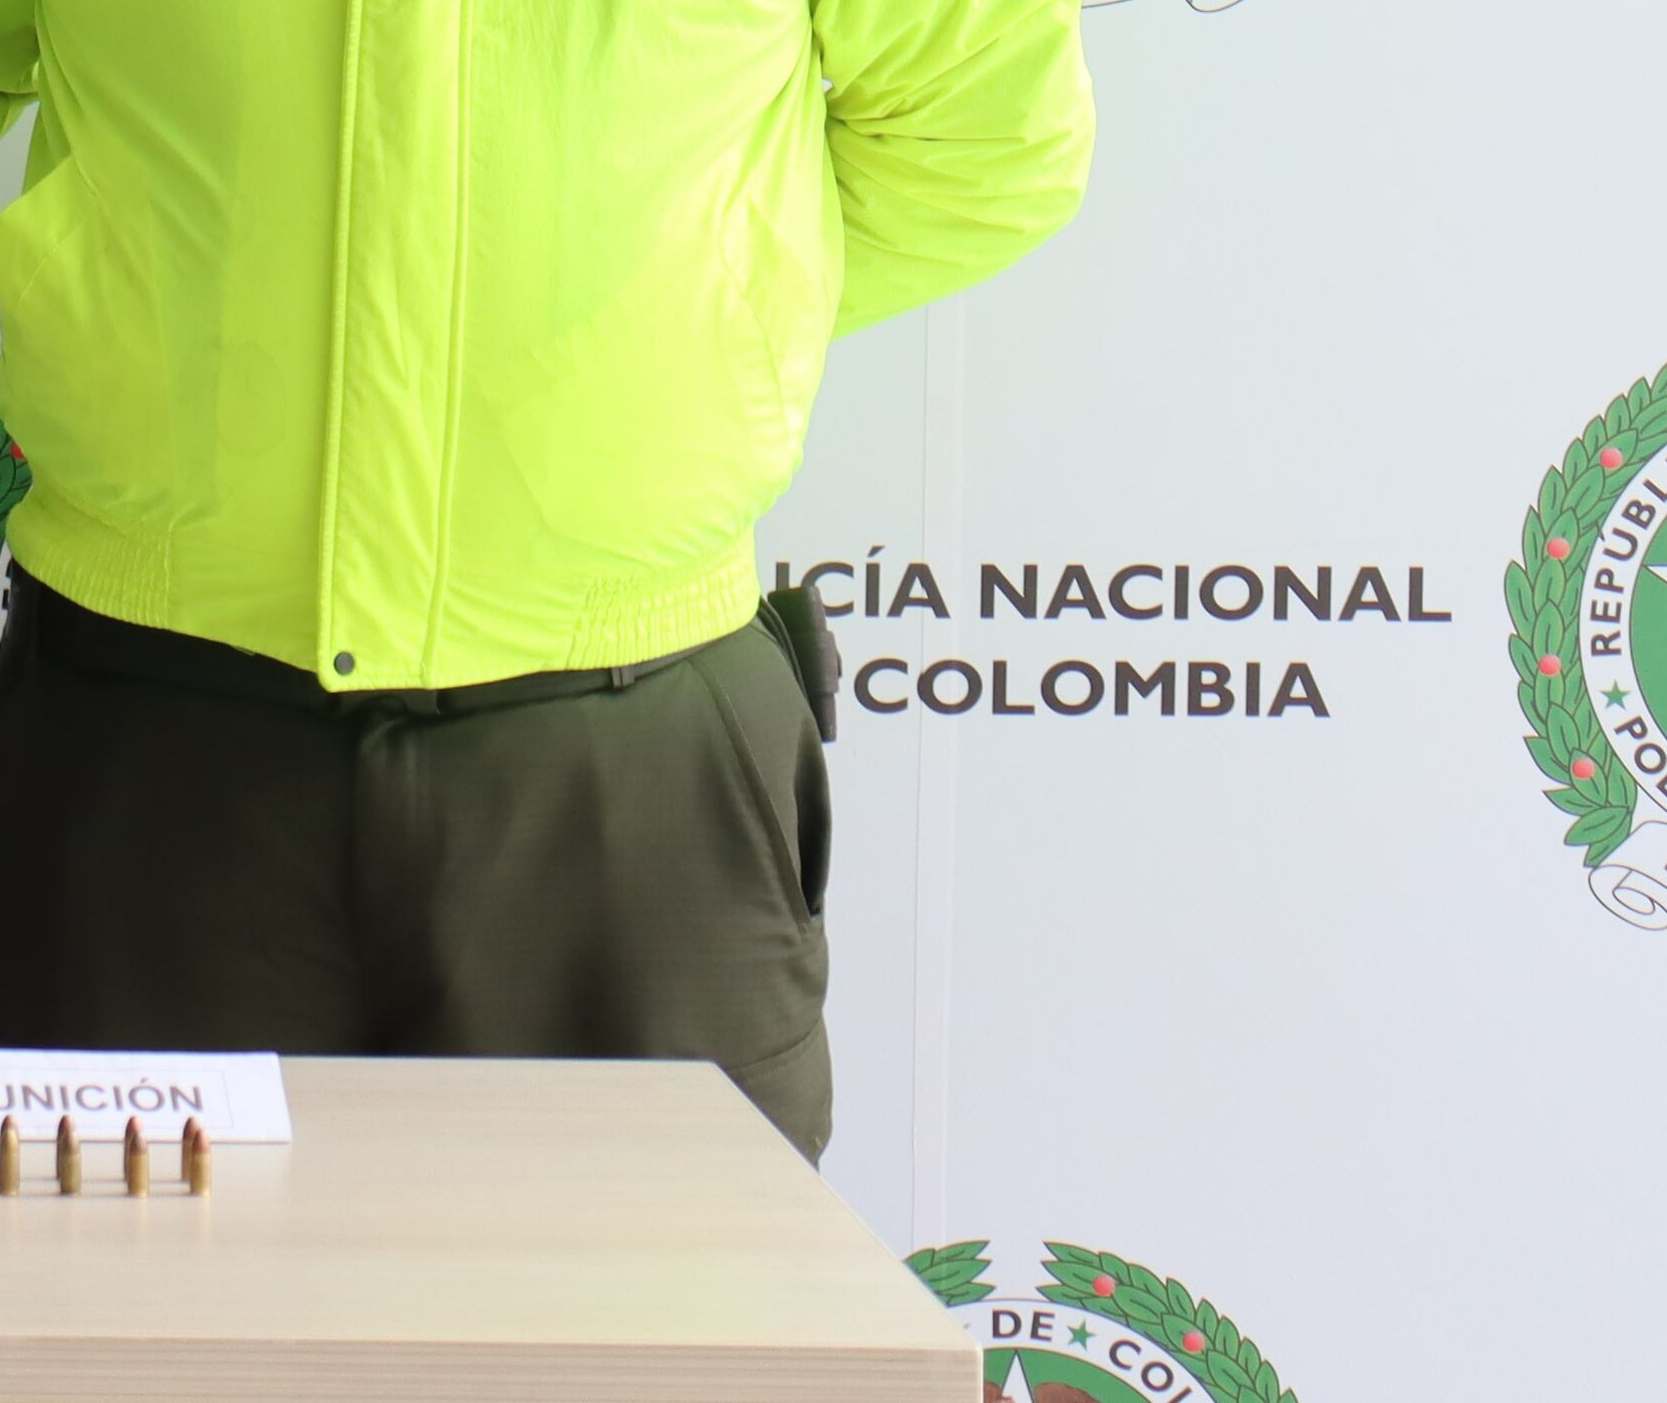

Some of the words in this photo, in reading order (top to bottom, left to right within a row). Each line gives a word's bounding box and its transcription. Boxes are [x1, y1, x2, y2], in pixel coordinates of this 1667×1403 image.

[776, 545, 951, 619] ICÍA
[980, 563, 1452, 623] NACIONAL
[854, 658, 1331, 719] COLOMBIA
[991, 1309, 1055, 1341] DE
